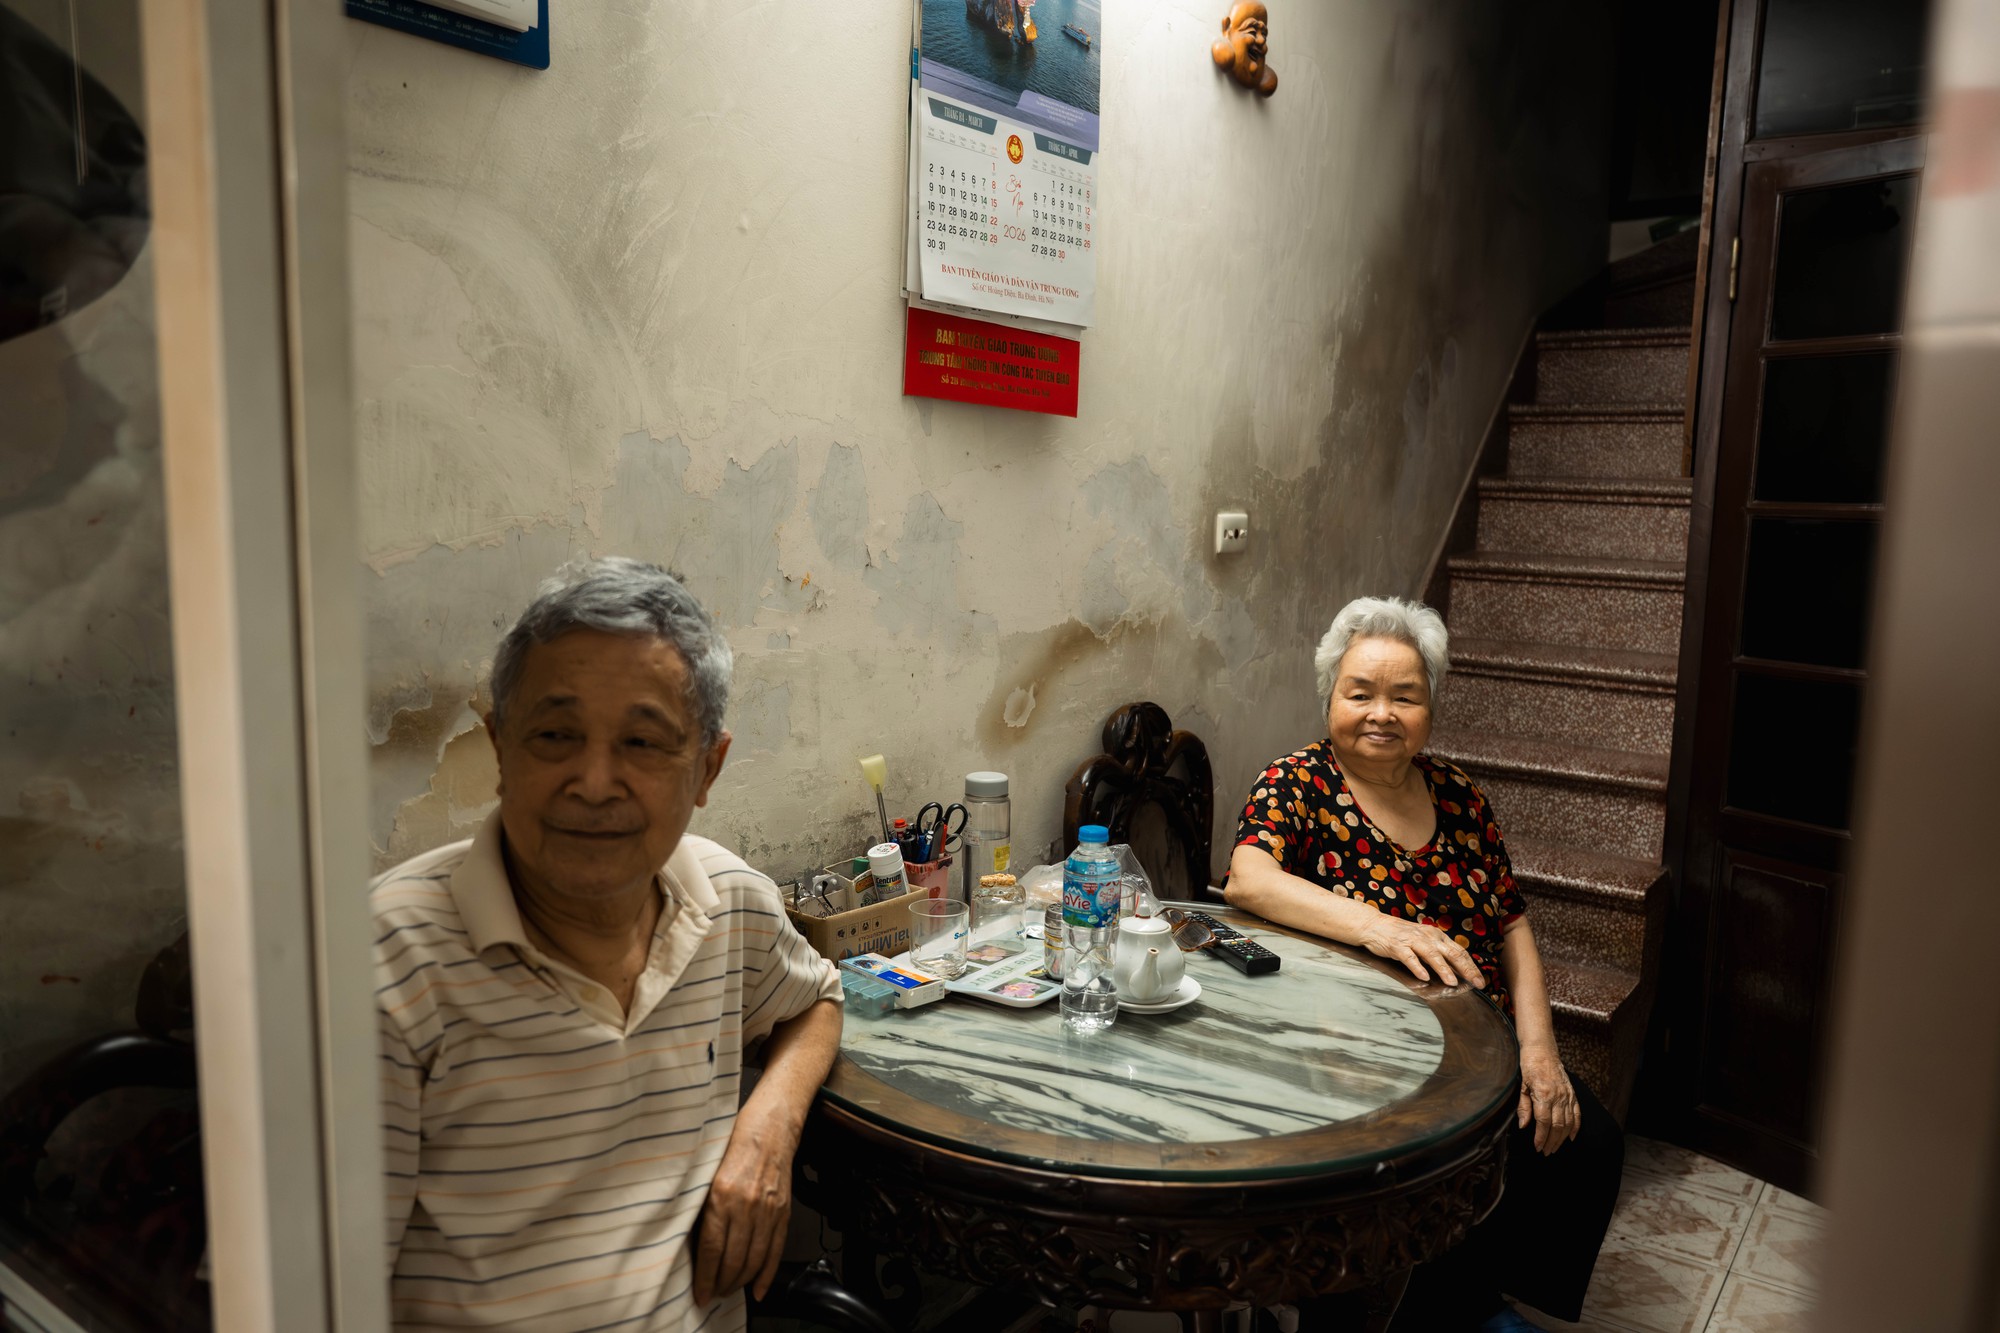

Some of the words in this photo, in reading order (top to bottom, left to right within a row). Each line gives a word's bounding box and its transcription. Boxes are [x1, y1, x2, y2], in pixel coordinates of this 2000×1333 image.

[968, 115, 983, 128] MARCH
[929, 163, 934, 173] 2
[940, 166, 945, 176] 3
[951, 170, 955, 178] 4
[961, 172, 966, 181] 5
[971, 175, 976, 184] 6
[982, 178, 986, 186] 7
[991, 181, 996, 190] 8
[992, 162, 996, 171] 1
[929, 182, 934, 192] 9
[939, 184, 946, 195] 10
[950, 188, 956, 197] 11
[960, 190, 967, 200] 12
[970, 192, 978, 203] 13
[980, 196, 987, 205] 14
[991, 198, 997, 207] 15
[1052, 180, 1055, 189] 1
[1060, 183, 1064, 192] 2
[1068, 185, 1073, 194] 3
[1077, 188, 1082, 196] 4
[1086, 190, 1090, 199] 5
[928, 201, 935, 211] 16
[939, 203, 946, 213] 17
[960, 208, 967, 219] 19
[970, 211, 978, 221] 20
[980, 214, 987, 223] 21
[990, 216, 998, 226] 22
[1033, 192, 1038, 201] 6
[1042, 195, 1047, 203] 7
[1051, 197, 1055, 206] 8
[1060, 200, 1065, 209] 9
[1067, 202, 1074, 211] 10
[1077, 204, 1082, 213] 11
[1084, 206, 1091, 216] 12
[927, 220, 936, 230] 23
[938, 222, 946, 232] 24
[948, 225, 957, 235] 25
[959, 227, 968, 237] 26
[969, 230, 978, 239] 27
[980, 232, 988, 242] 28
[990, 234, 998, 244] 29
[1032, 209, 1039, 219] 13
[1041, 211, 1048, 221] 14
[1050, 214, 1057, 223] 15
[1059, 216, 1065, 226] 16
[1067, 218, 1074, 228] 17
[1076, 221, 1083, 230] 18
[1084, 222, 1091, 232] 19
[927, 238, 936, 249] 30
[938, 241, 946, 251] 31
[1003, 224, 1027, 242] 2026
[1031, 226, 1040, 236] 20
[1041, 229, 1048, 238] 21
[1050, 231, 1057, 241] 22
[1058, 233, 1066, 243] 23
[1067, 235, 1074, 244] 24
[1075, 237, 1083, 247] 25
[1083, 239, 1091, 249] 26
[1031, 243, 1039, 253] 27
[1040, 246, 1048, 256] 28
[1049, 248, 1057, 258] 29
[1057, 250, 1066, 260] 30
[941, 264, 956, 274] BAN
[957, 267, 981, 279] TUYÊN
[982, 272, 1000, 283] GIÁO
[1000, 274, 1010, 286] VÀ
[1011, 277, 1025, 288] DÂN
[1025, 279, 1039, 292] VẬN
[1039, 283, 1061, 295] TRUNG
[936, 328, 956, 345] BAN
[1010, 342, 1036, 359] TRUNG
[920, 350, 945, 367] TRUNG
[989, 361, 1000, 374] TIN
[1002, 362, 1020, 378] CÔNG
[941, 373, 949, 384] Số
[950, 376, 959, 385] 2B
[875, 873, 901, 884] Centrum
[1064, 893, 1091, 910] aVie
